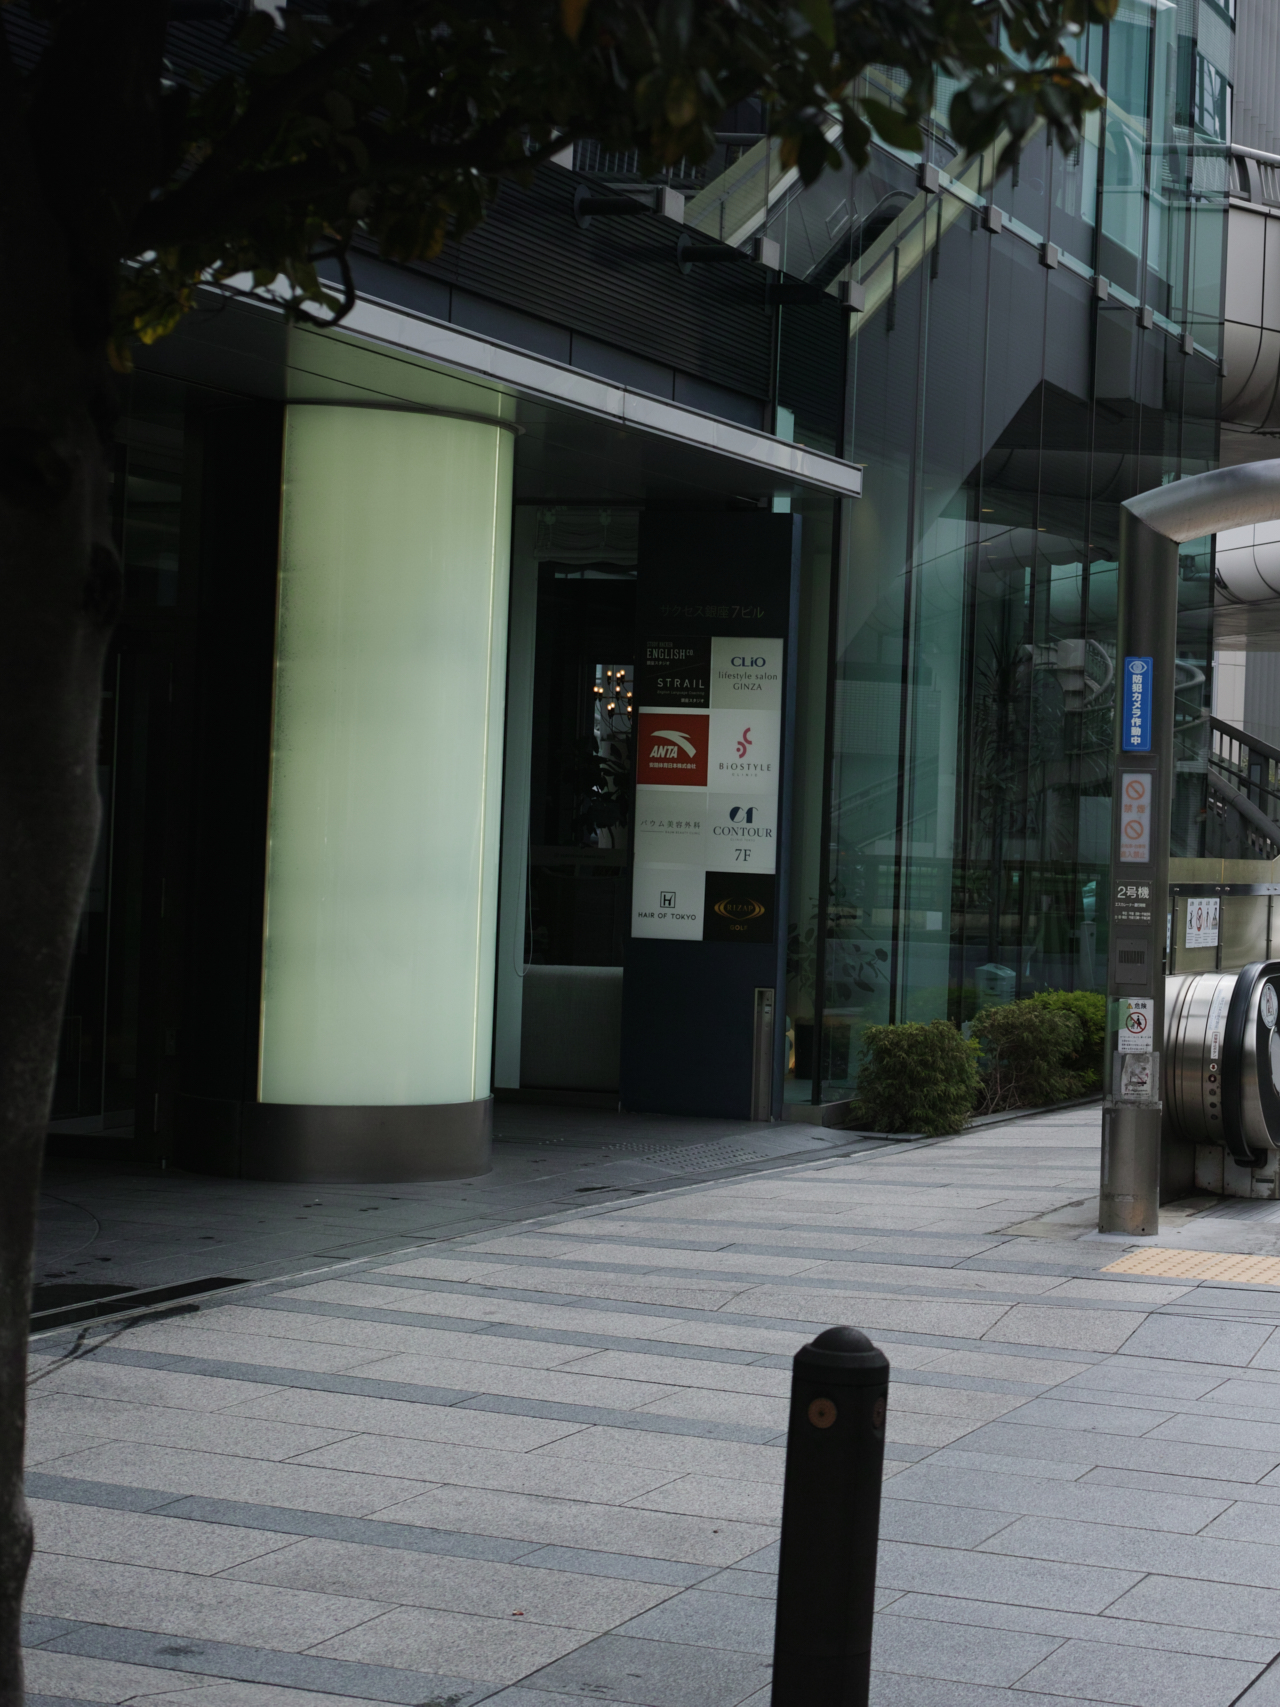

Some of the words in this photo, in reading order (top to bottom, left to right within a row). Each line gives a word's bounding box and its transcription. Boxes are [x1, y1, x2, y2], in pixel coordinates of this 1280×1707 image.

[646, 648, 686, 660] ENGLISH
[718, 671, 752, 681] lifestyle
[755, 673, 778, 681] salon
[657, 678, 705, 688] STRAIL
[733, 683, 762, 691] GINZA
[1130, 674, 1143, 746] 防犯カメラ作動中
[649, 745, 678, 758] ANTA
[640, 819, 700, 829] バウム美容外科
[713, 826, 772, 838] CONTOUR
[735, 848, 751, 861] 7F
[1117, 885, 1150, 899] 2号機
[727, 904, 754, 912] RIZAP
[638, 911, 655, 919] HAIR
[671, 913, 697, 921] TOKYO
[1134, 1002, 1147, 1010] 危険
